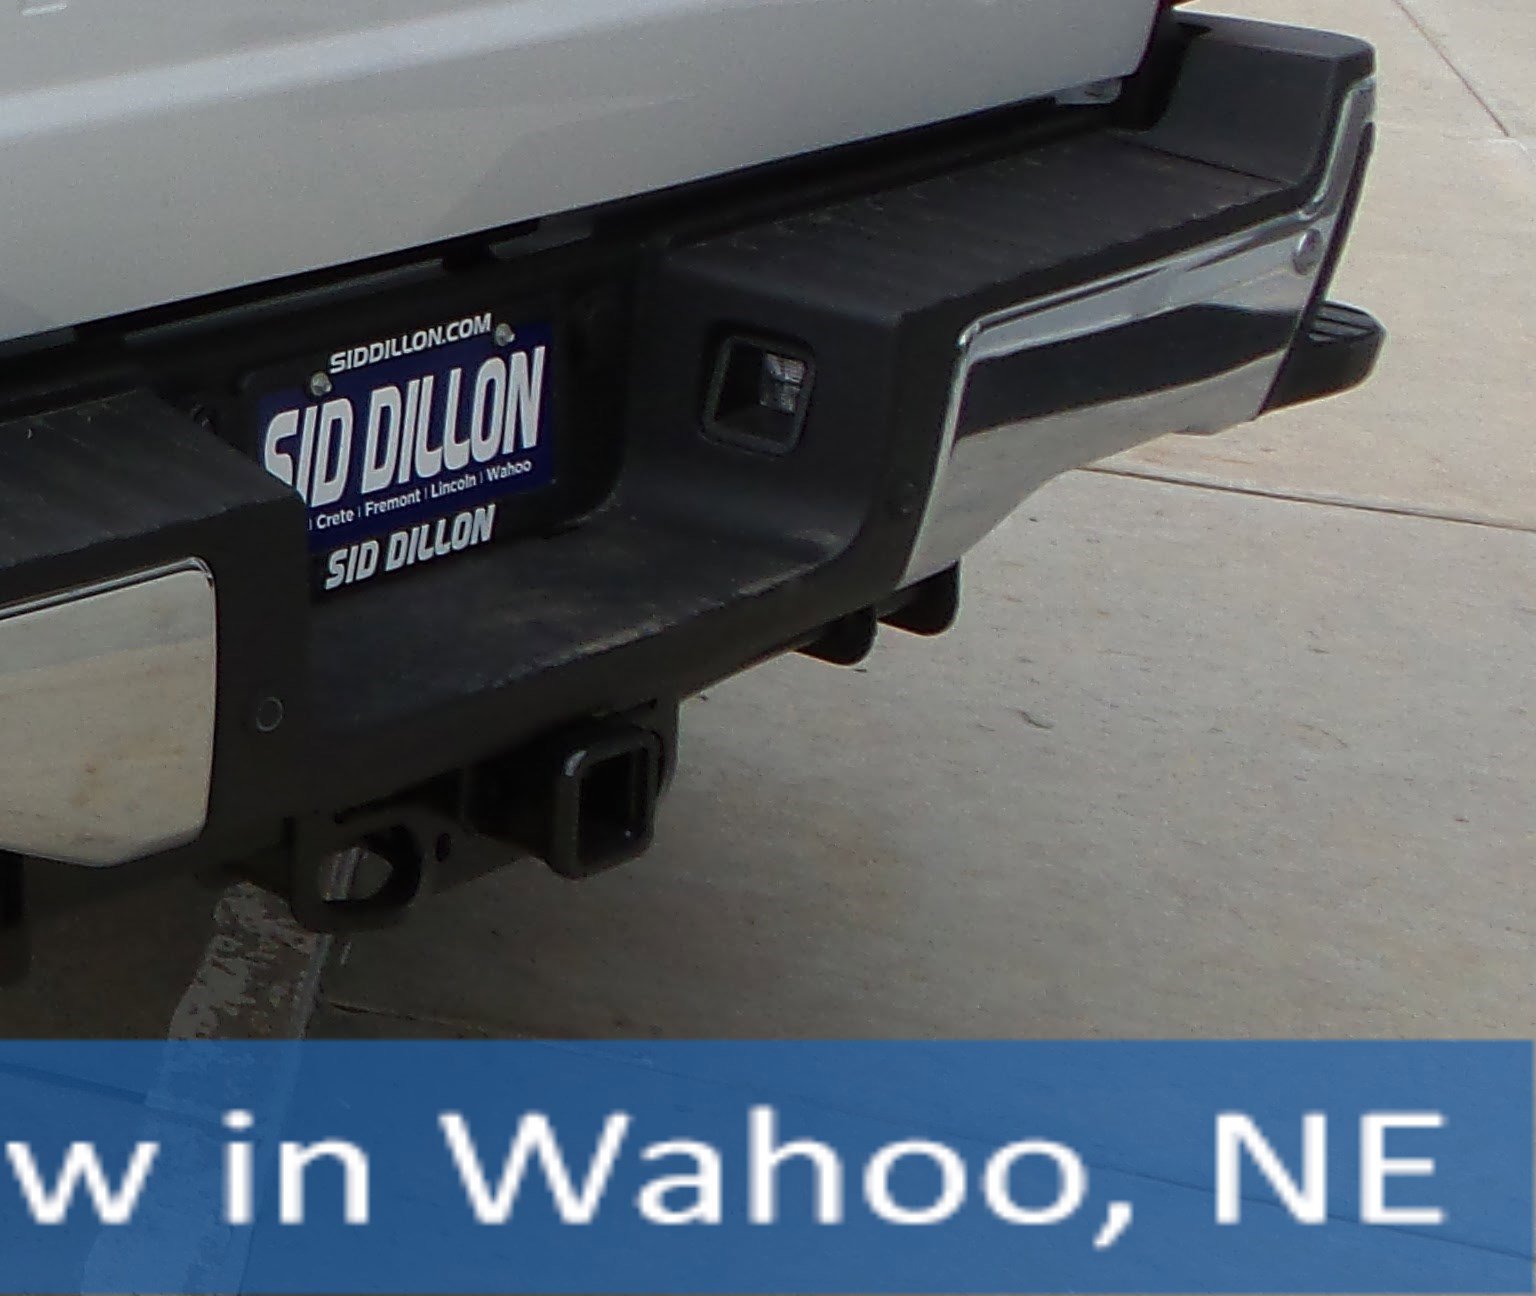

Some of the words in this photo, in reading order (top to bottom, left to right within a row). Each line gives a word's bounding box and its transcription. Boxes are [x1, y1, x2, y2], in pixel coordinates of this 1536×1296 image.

[329, 312, 492, 375] SIDDILLON.COM
[263, 397, 354, 508] SID
[360, 346, 546, 494] DILLON
[316, 509, 354, 530] Crete
[364, 489, 421, 516] Fremont
[430, 473, 477, 499] Lincoln
[486, 458, 532, 482] Wahoo
[324, 538, 380, 590] SID
[385, 503, 496, 572] DILLON
